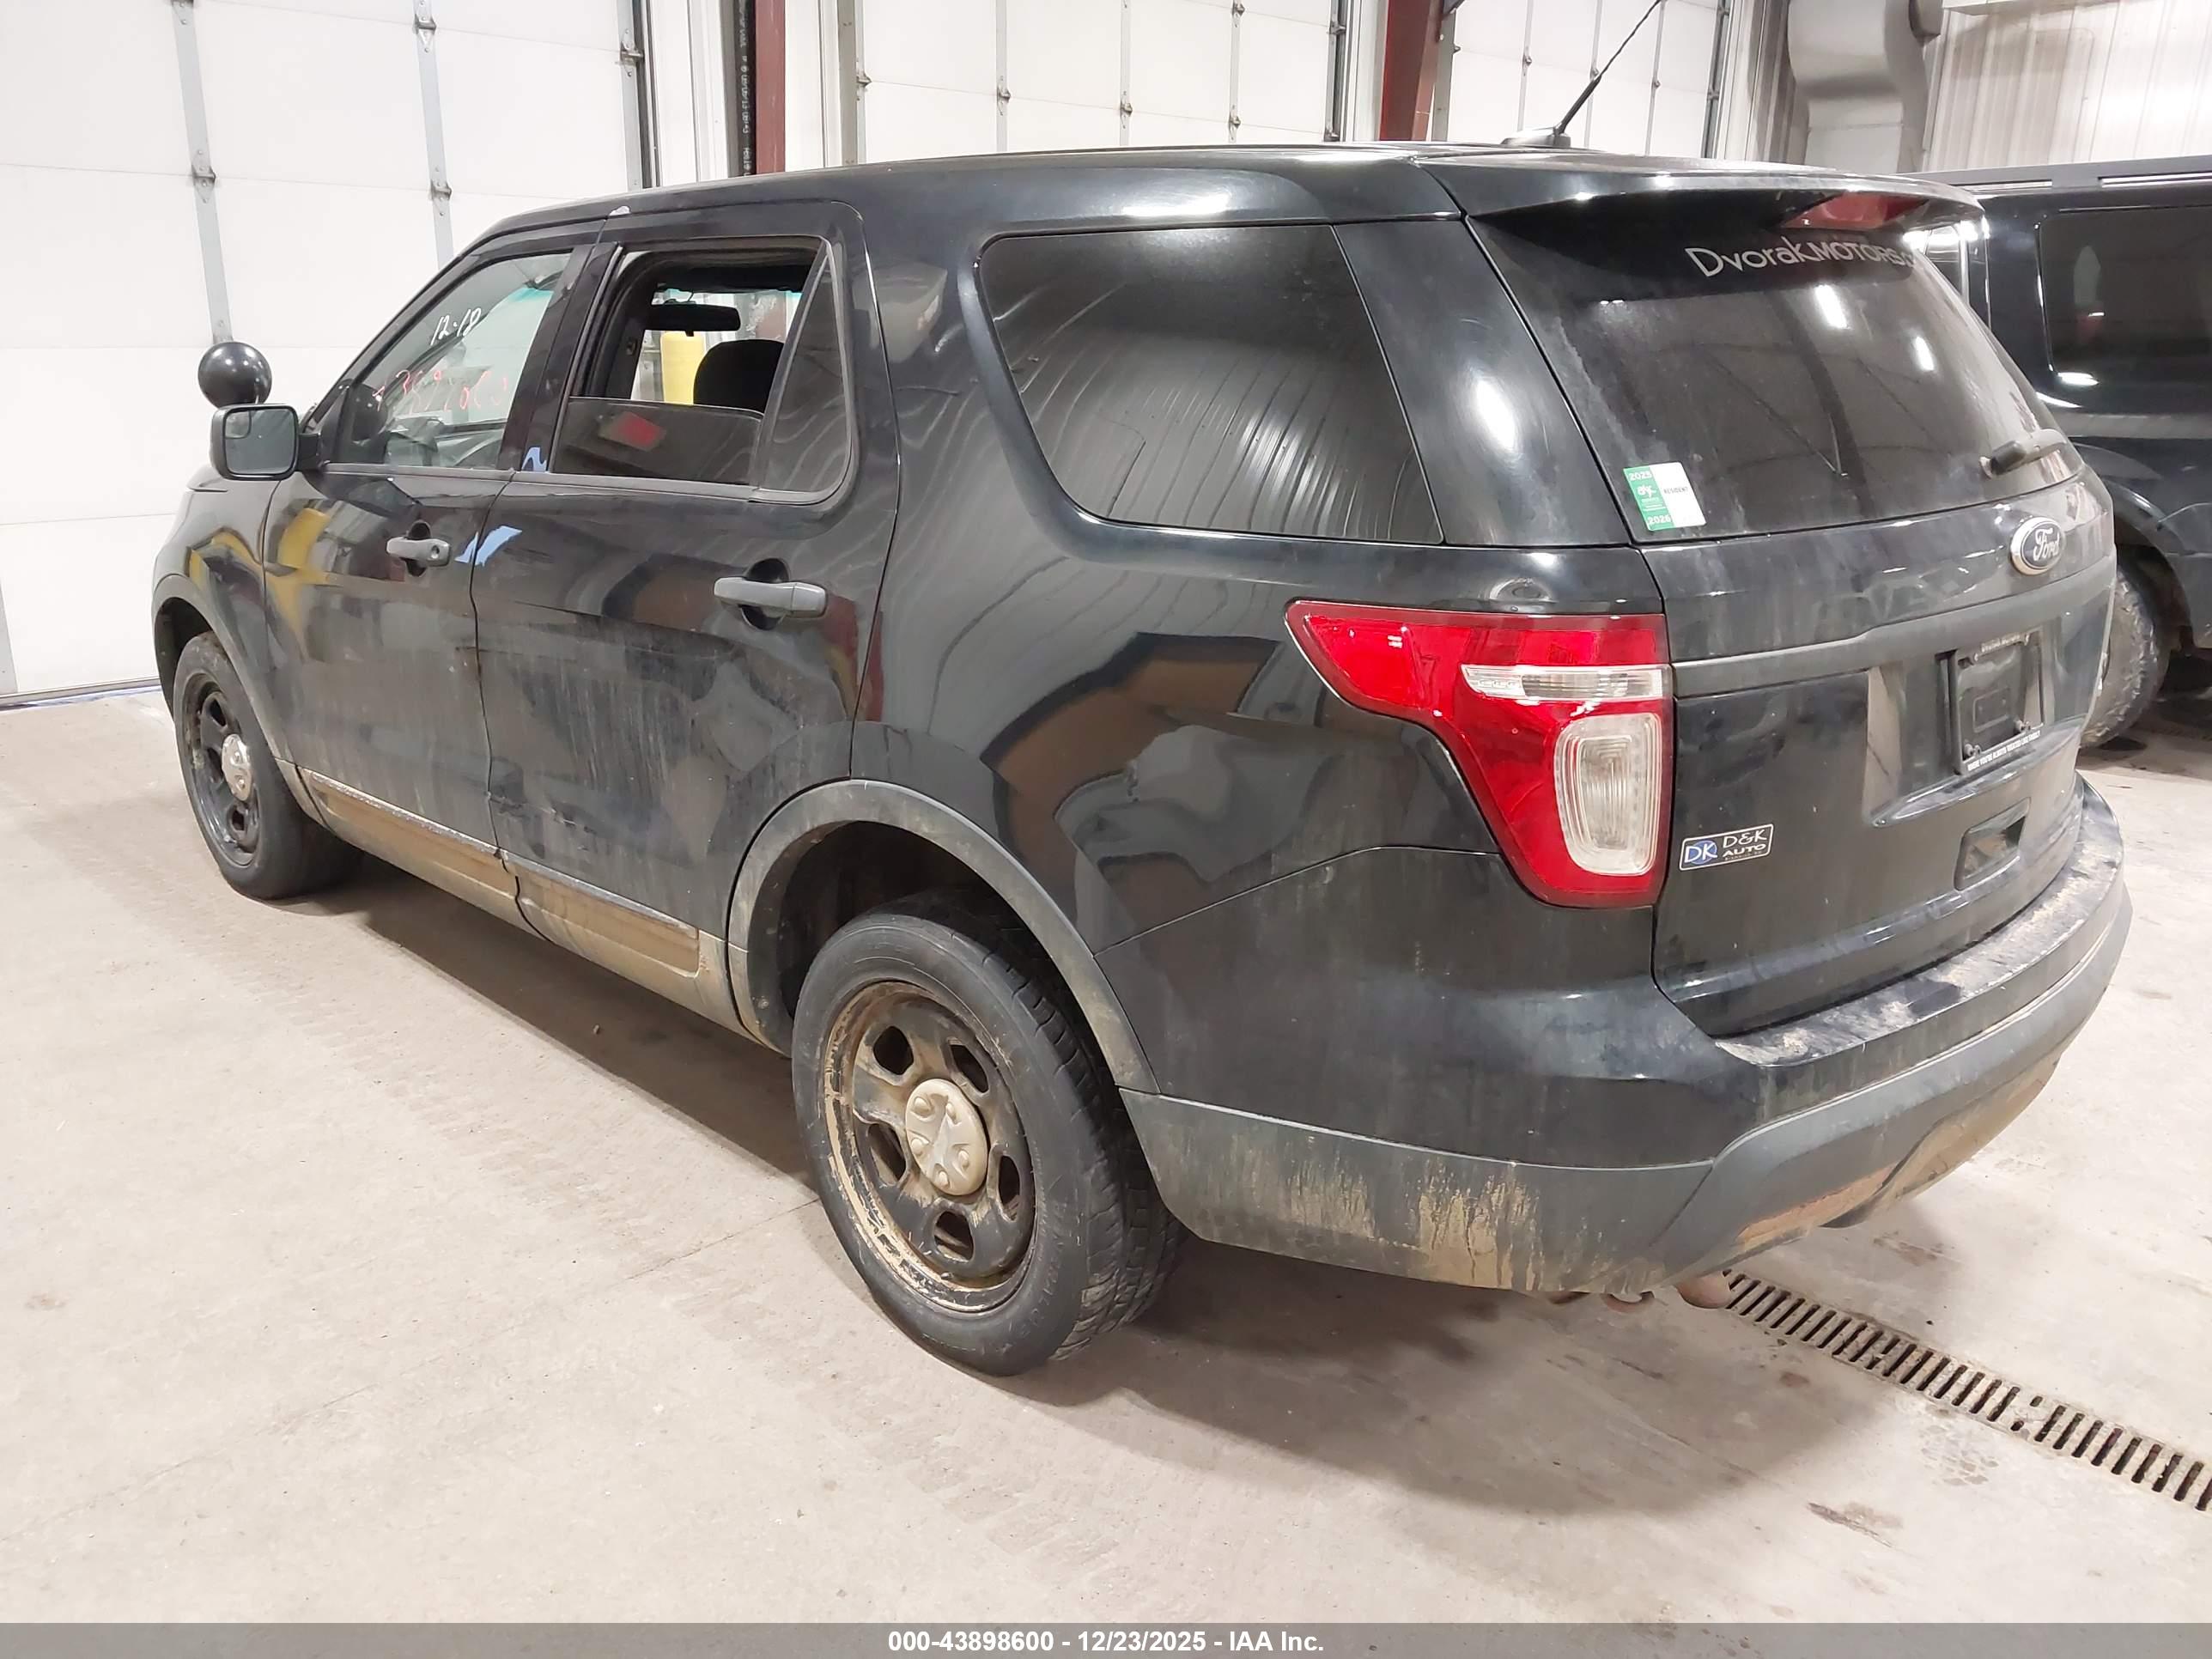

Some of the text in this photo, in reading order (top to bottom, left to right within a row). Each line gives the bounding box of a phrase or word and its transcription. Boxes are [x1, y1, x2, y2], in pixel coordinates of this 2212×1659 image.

[2033, 527, 2060, 561] Ford
[1723, 829, 1767, 848] D&K
[1684, 842, 1718, 864] DK
[1723, 844, 1766, 858] AUTO
